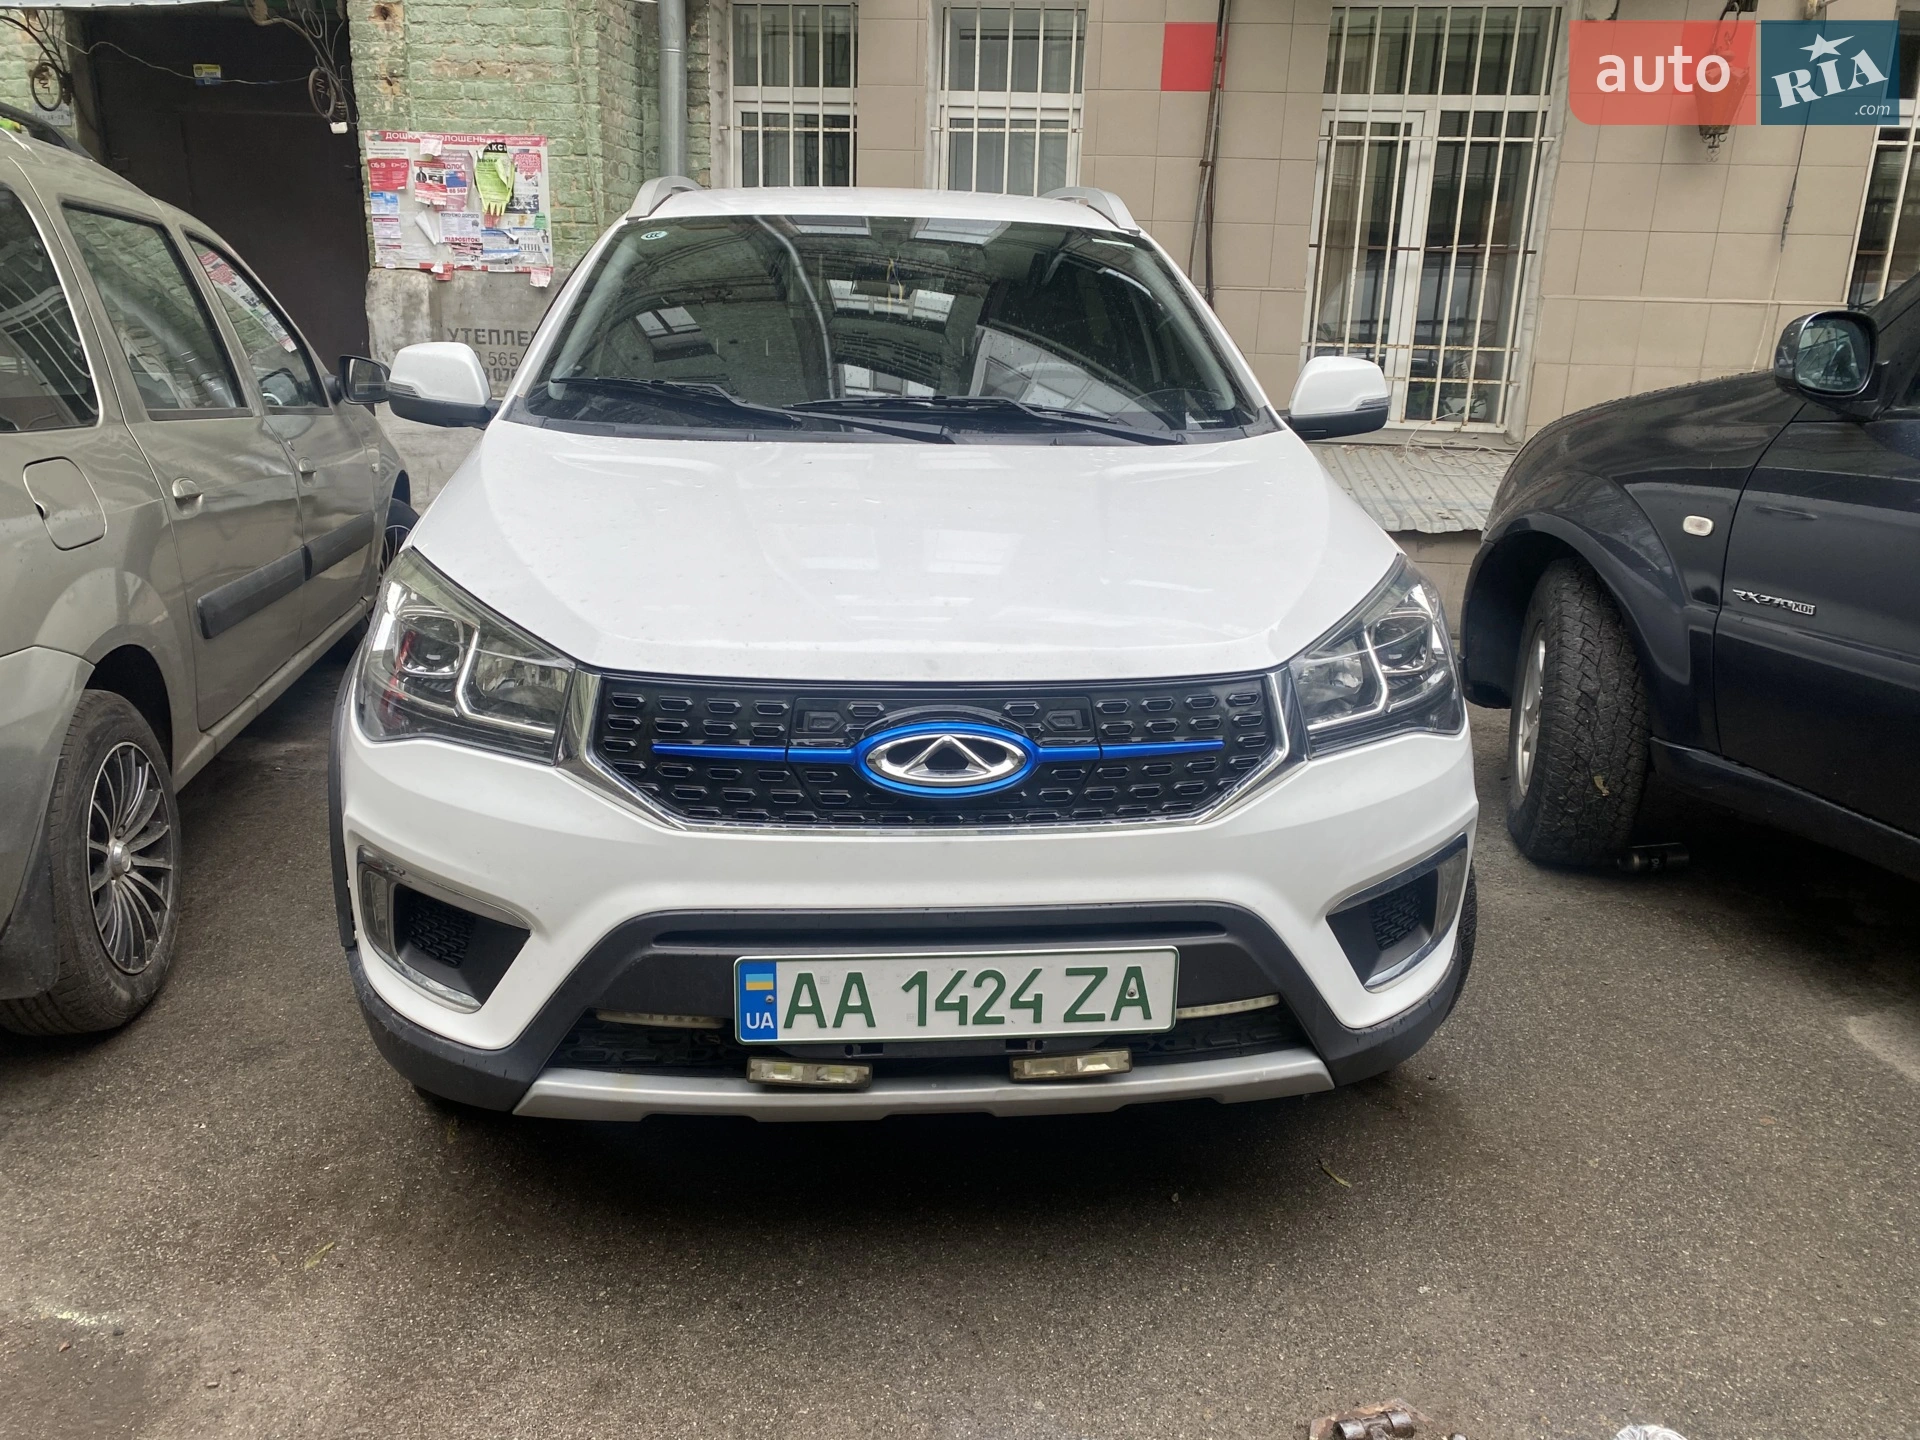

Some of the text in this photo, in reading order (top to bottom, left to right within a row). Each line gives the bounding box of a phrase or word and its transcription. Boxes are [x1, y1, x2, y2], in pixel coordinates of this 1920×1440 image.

[386, 131, 486, 143] ДОШКА ОЛОШЕНЬ
[447, 327, 537, 347] УТЕПЛЕ
[488, 351, 518, 367] 565
[783, 966, 1152, 1029] AA 1424 ZA
[746, 1013, 774, 1029] UA
